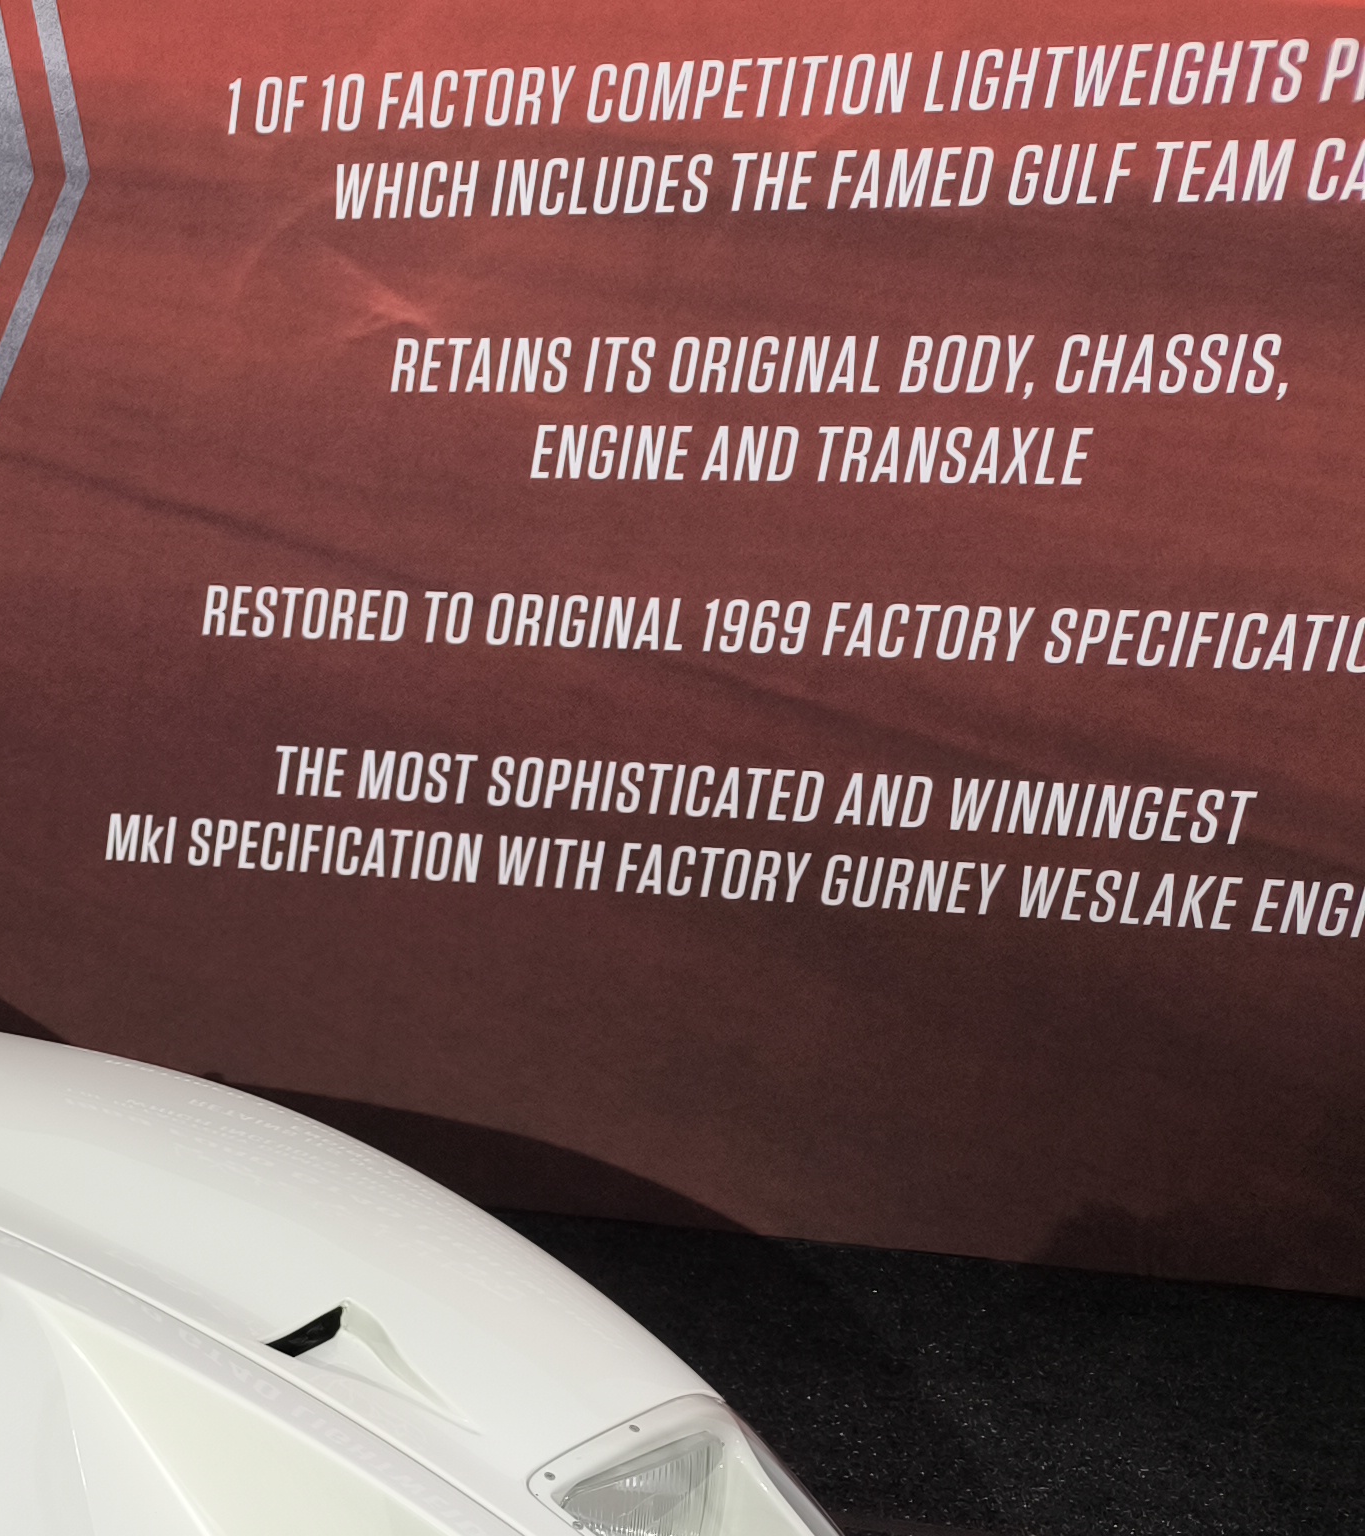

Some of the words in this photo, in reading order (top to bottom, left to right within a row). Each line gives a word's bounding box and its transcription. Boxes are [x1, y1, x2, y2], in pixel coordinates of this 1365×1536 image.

[227, 77, 242, 135] 1
[255, 75, 308, 134] OF
[321, 73, 365, 132] 10
[377, 65, 577, 130] FACTORY
[586, 51, 913, 124] COMPETITION
[923, 38, 1310, 113] LIGHTWEIGHTS
[335, 160, 480, 220] WHICH
[490, 153, 714, 217] INCLUDES
[731, 150, 817, 212] THE
[826, 146, 995, 210] FAMED
[1007, 142, 1138, 206] GULF
[1152, 138, 1297, 203] TEAM
[390, 336, 572, 393] RETAINS
[583, 336, 656, 393] ITS
[668, 335, 880, 394] ORIGINAL
[898, 334, 1035, 400] BODY,
[1055, 333, 1288, 401] CHASSIS,
[530, 424, 693, 481] ENGINE
[701, 425, 800, 482] AND
[817, 426, 1094, 485] TRANSAXLE
[202, 584, 409, 642] RESTORED
[424, 590, 474, 645] TO
[486, 592, 683, 651] ORIGINAL
[702, 598, 811, 655] 1969
[822, 601, 1036, 662] FACTORY
[276, 745, 348, 798] THE
[357, 749, 479, 804] MOST
[487, 755, 825, 822] SOPHISTICATED
[834, 772, 933, 828] AND
[950, 777, 1258, 845] WINNINGEST
[187, 817, 483, 883] SPECIFICATION
[498, 835, 606, 891] WITH
[616, 842, 812, 903] FACTORY
[821, 854, 1007, 915] GURNEY
[1019, 865, 1244, 930] WESLAKE
